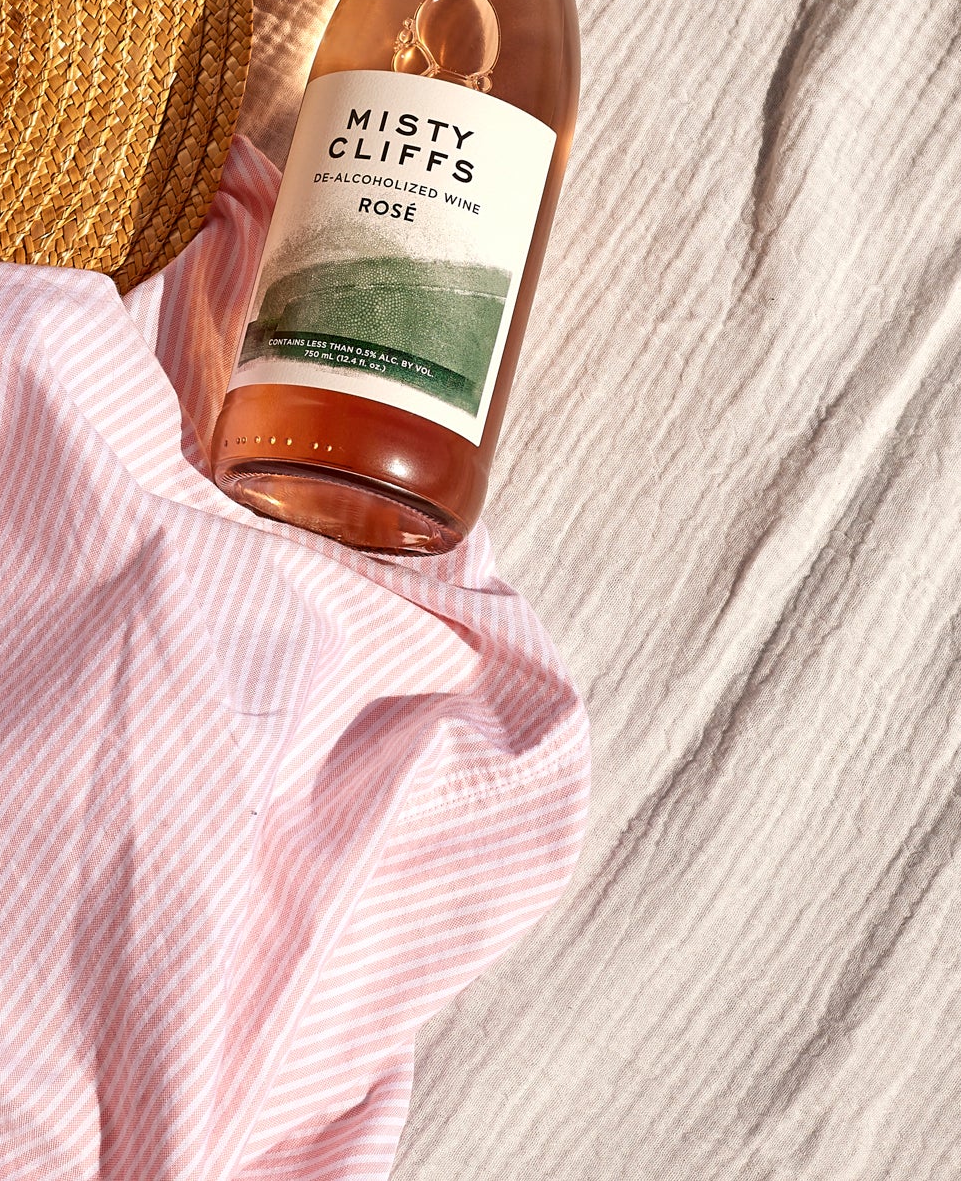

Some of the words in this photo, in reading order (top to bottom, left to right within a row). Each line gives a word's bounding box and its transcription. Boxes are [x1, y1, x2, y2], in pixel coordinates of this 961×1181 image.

[346, 108, 474, 150] MISTY
[328, 137, 475, 184] CLIFFS
[313, 172, 438, 199] DE-ALCOHOLIZED
[444, 192, 481, 215] WINE
[358, 197, 417, 222] ROSÉ
[268, 338, 305, 346] CONTAINS
[306, 340, 327, 349] LESS
[329, 342, 354, 354] THAN
[355, 347, 377, 359] 0.5%
[378, 353, 399, 365] ALC.
[401, 359, 414, 369] BY
[415, 364, 434, 378] VOL.
[304, 349, 320, 358] 750
[321, 352, 334, 360] mL
[336, 354, 357, 365] (12.4
[358, 359, 367, 367] fl.
[369, 362, 386, 373] oz.)
